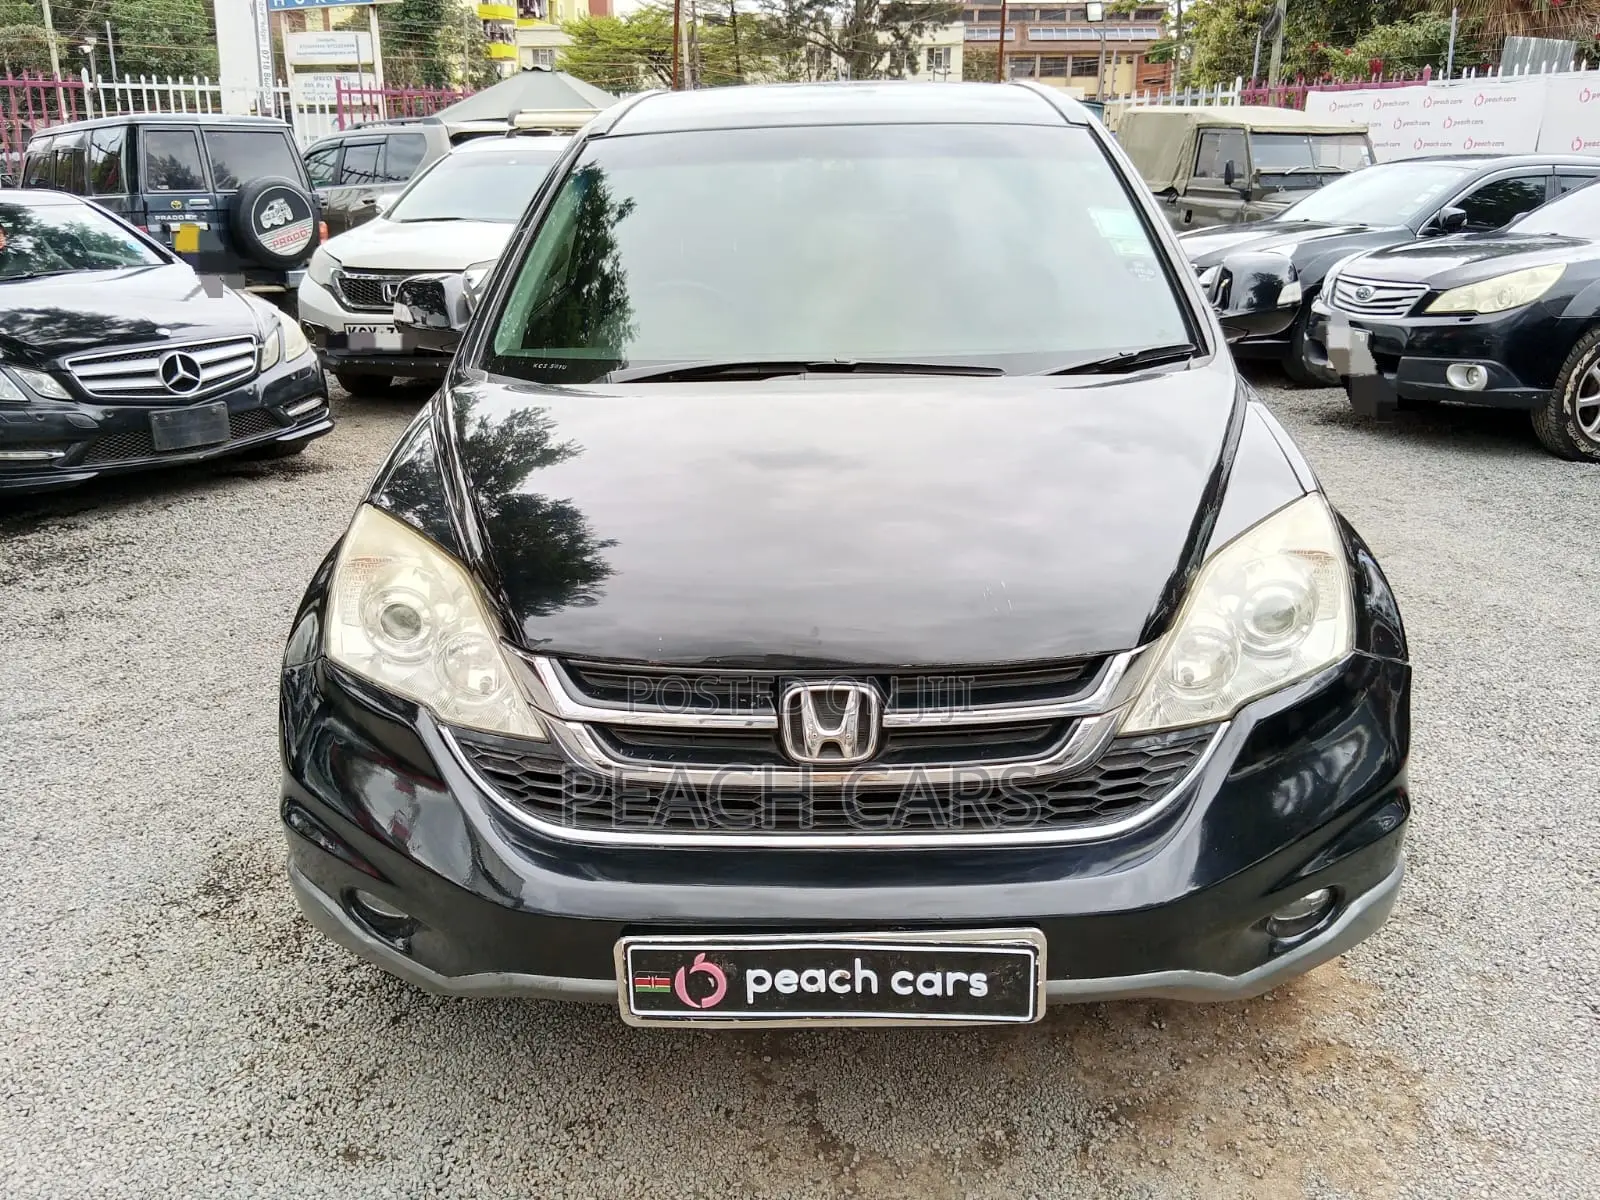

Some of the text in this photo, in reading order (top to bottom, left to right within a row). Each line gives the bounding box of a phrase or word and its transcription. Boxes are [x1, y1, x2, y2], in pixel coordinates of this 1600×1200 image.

[271, 230, 307, 248] PRADO
[745, 957, 989, 1004] peach cars
